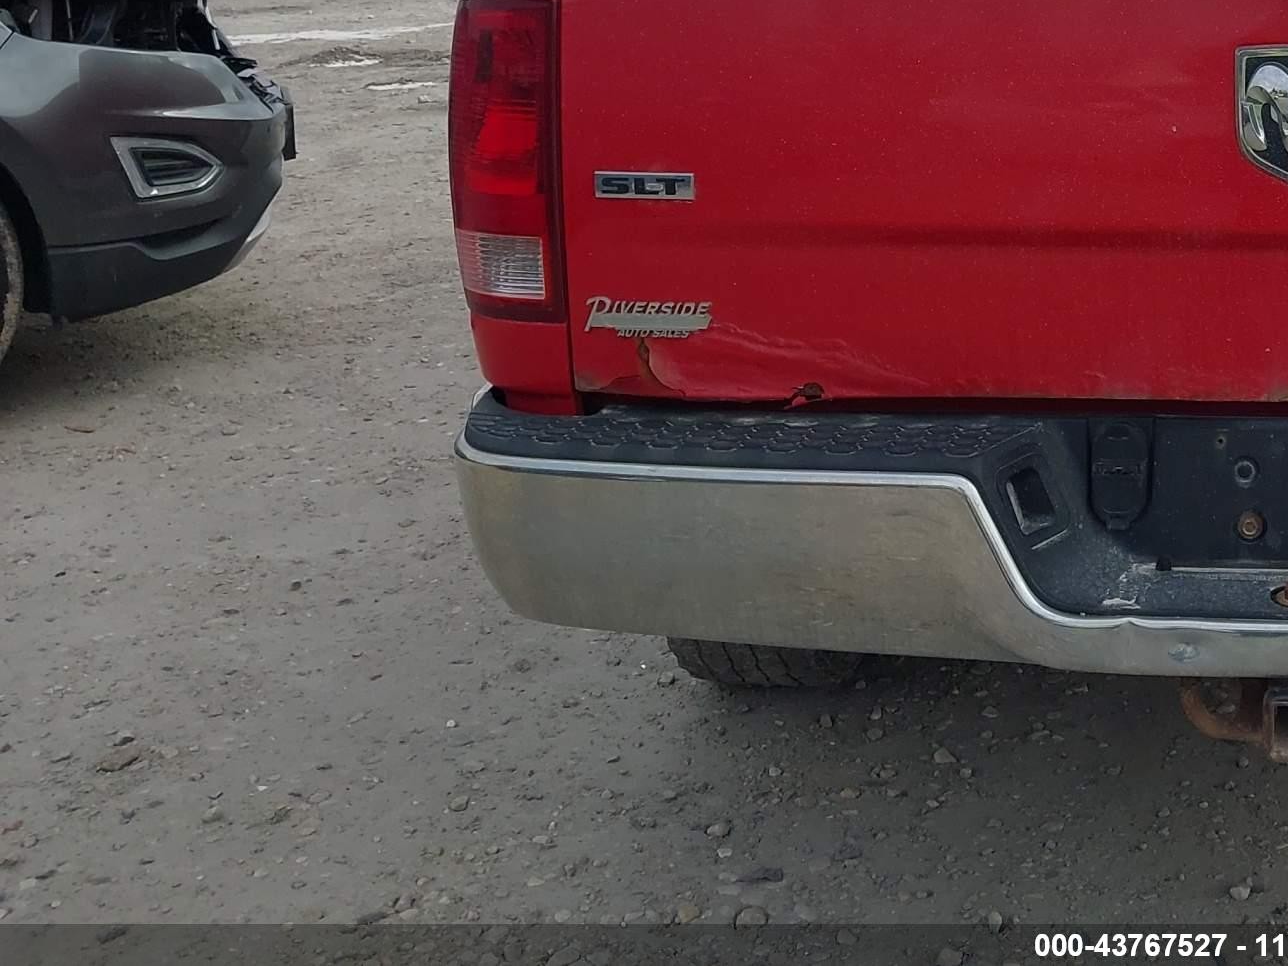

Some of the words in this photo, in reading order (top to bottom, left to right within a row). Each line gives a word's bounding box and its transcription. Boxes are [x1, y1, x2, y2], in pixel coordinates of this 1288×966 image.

[601, 177, 686, 196] SLT
[584, 295, 713, 332] RIVERSIDE
[617, 327, 650, 338] AUTO
[652, 328, 690, 339] SALES
